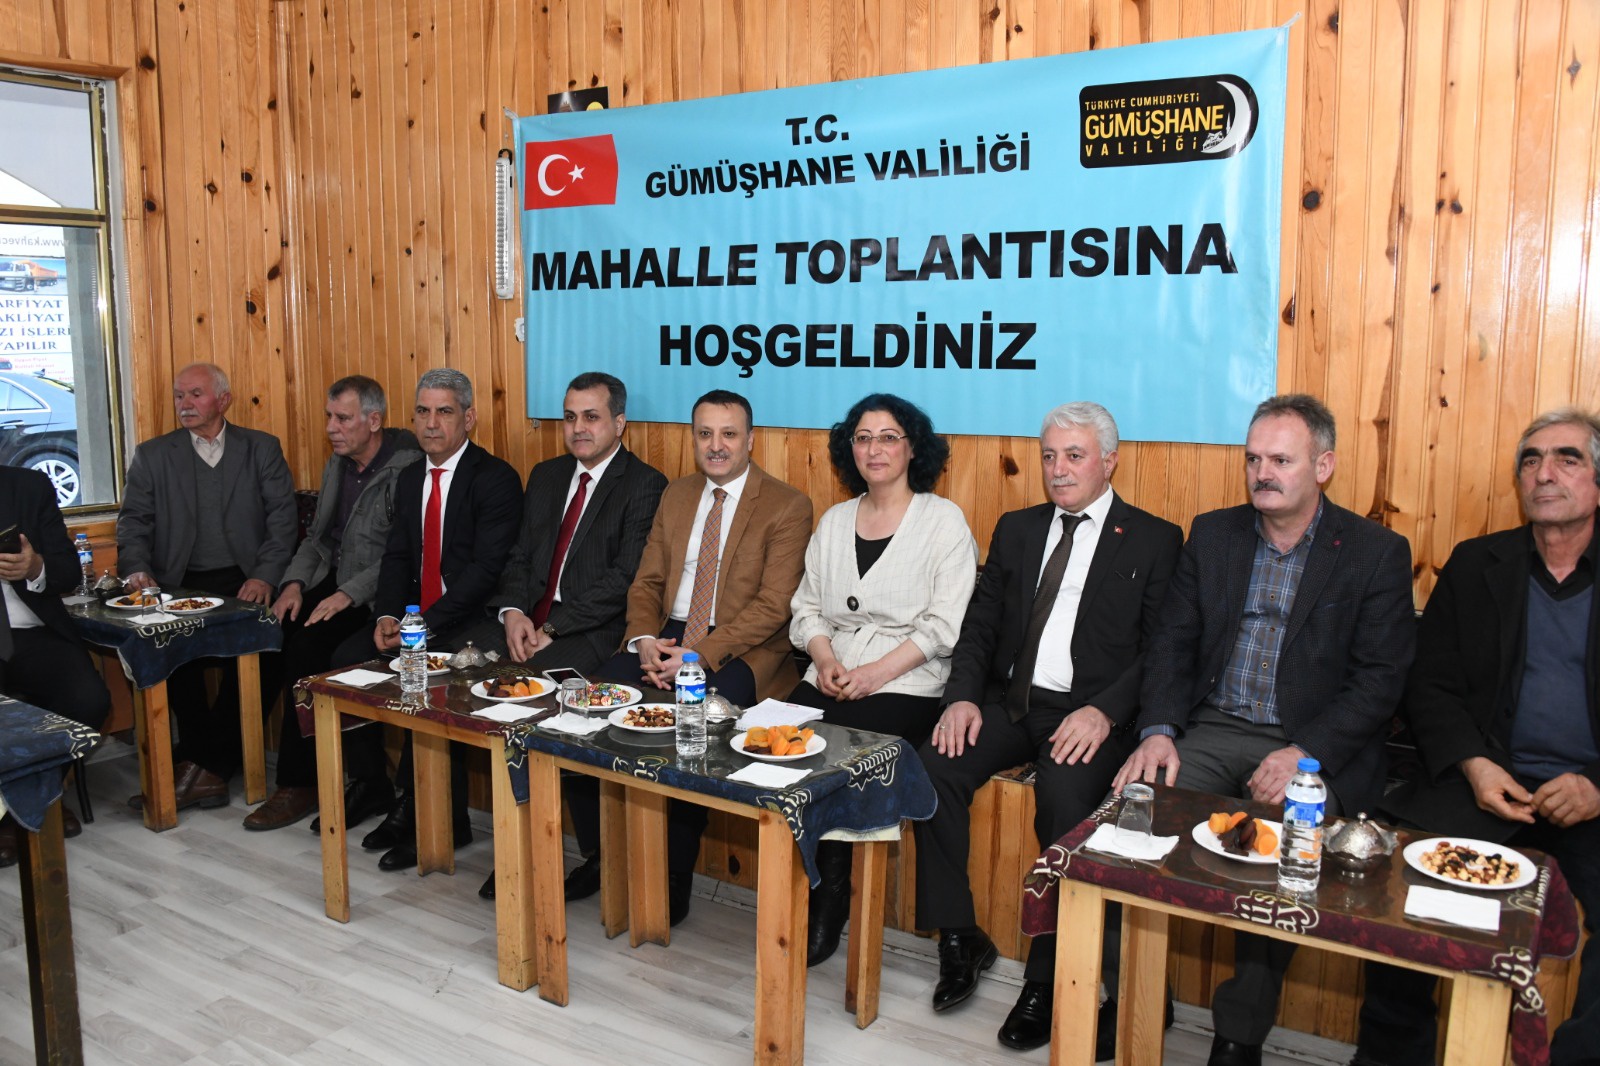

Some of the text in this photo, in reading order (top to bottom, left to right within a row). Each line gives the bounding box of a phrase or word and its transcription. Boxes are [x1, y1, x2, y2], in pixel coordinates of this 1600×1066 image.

[1084, 92, 1200, 111] TÜRKİYE CUMHURİYETİ
[784, 113, 849, 146] T.C.
[1084, 104, 1225, 140] GÜMÜŞHANE
[1085, 135, 1197, 157] VALİLİĞİ
[645, 132, 1031, 199] GÜMÜŞHANE VALİLİĞİ
[531, 223, 1239, 291] MAHALLE TOPLANTISINA
[659, 310, 1037, 379] HOŞGELDİNİZ
